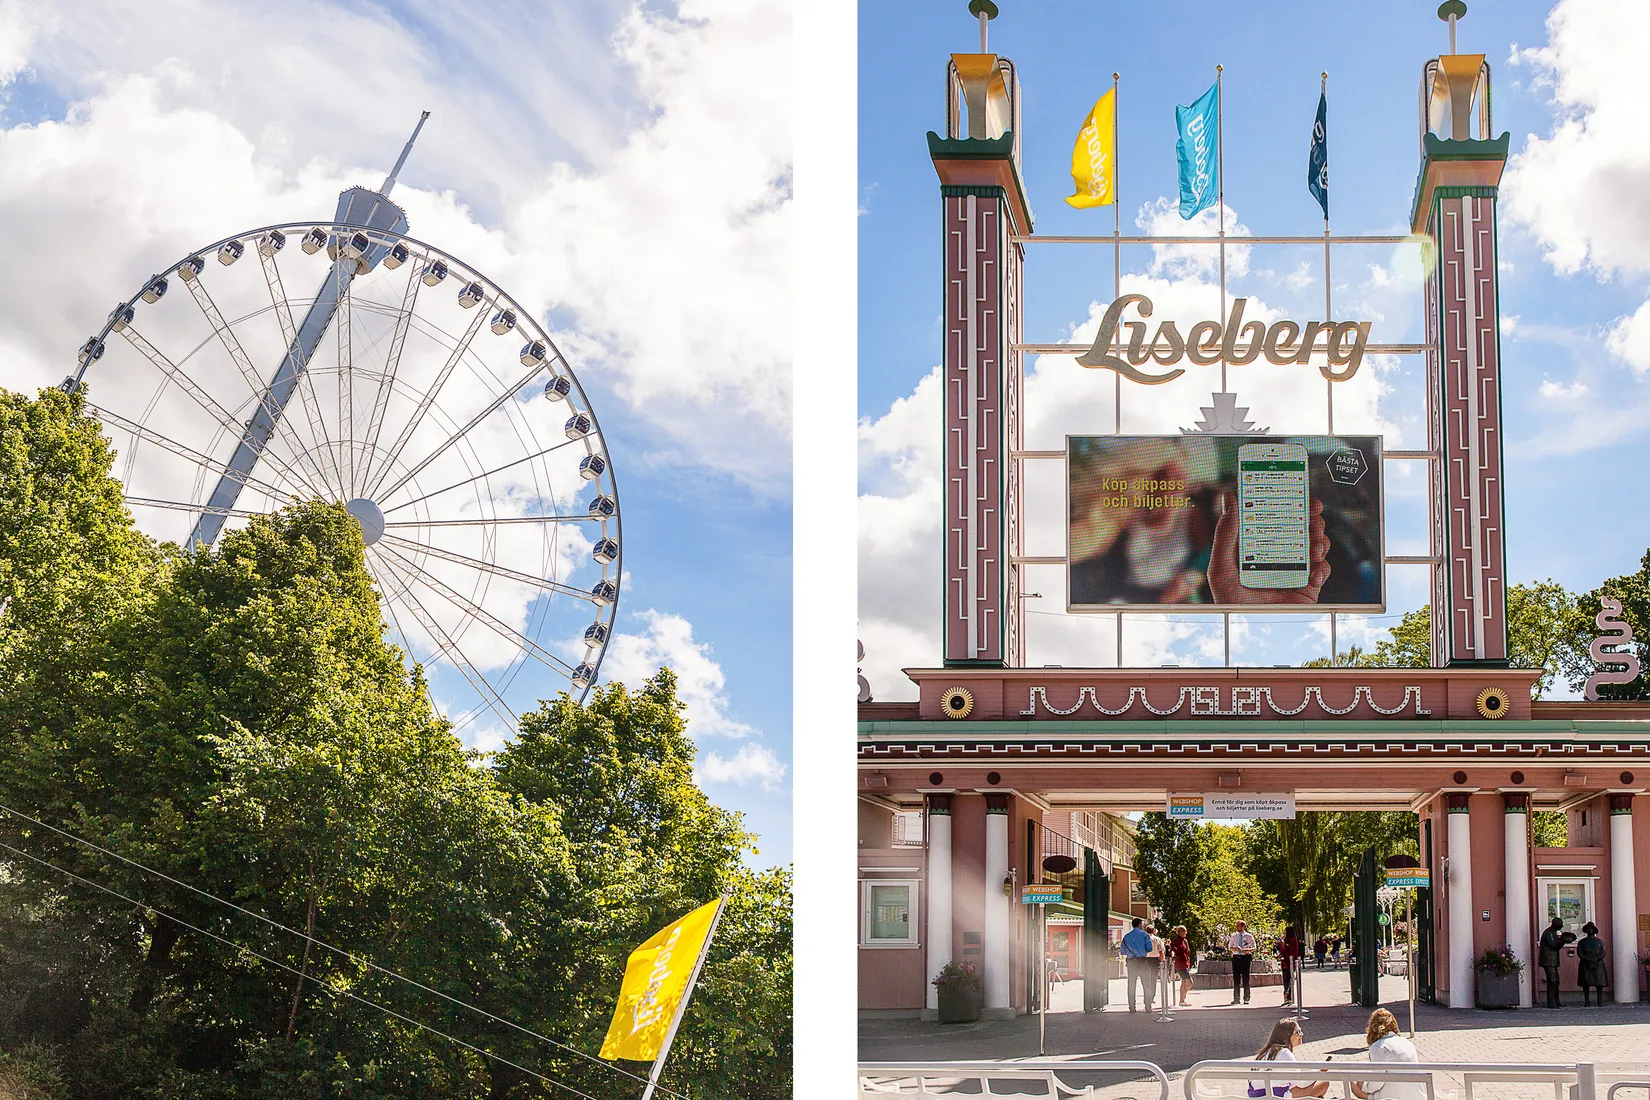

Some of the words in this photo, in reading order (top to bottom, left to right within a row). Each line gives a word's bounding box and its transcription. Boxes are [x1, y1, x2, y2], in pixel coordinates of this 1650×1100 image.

[1075, 293, 1372, 385] Liseberg
[1336, 455, 1359, 466] BÄSTA
[1335, 464, 1358, 475] TIPSET
[1102, 477, 1128, 493] Köp
[1133, 477, 1185, 493] åkpass
[1103, 495, 1128, 508] och
[1133, 495, 1195, 510] biljetter.
